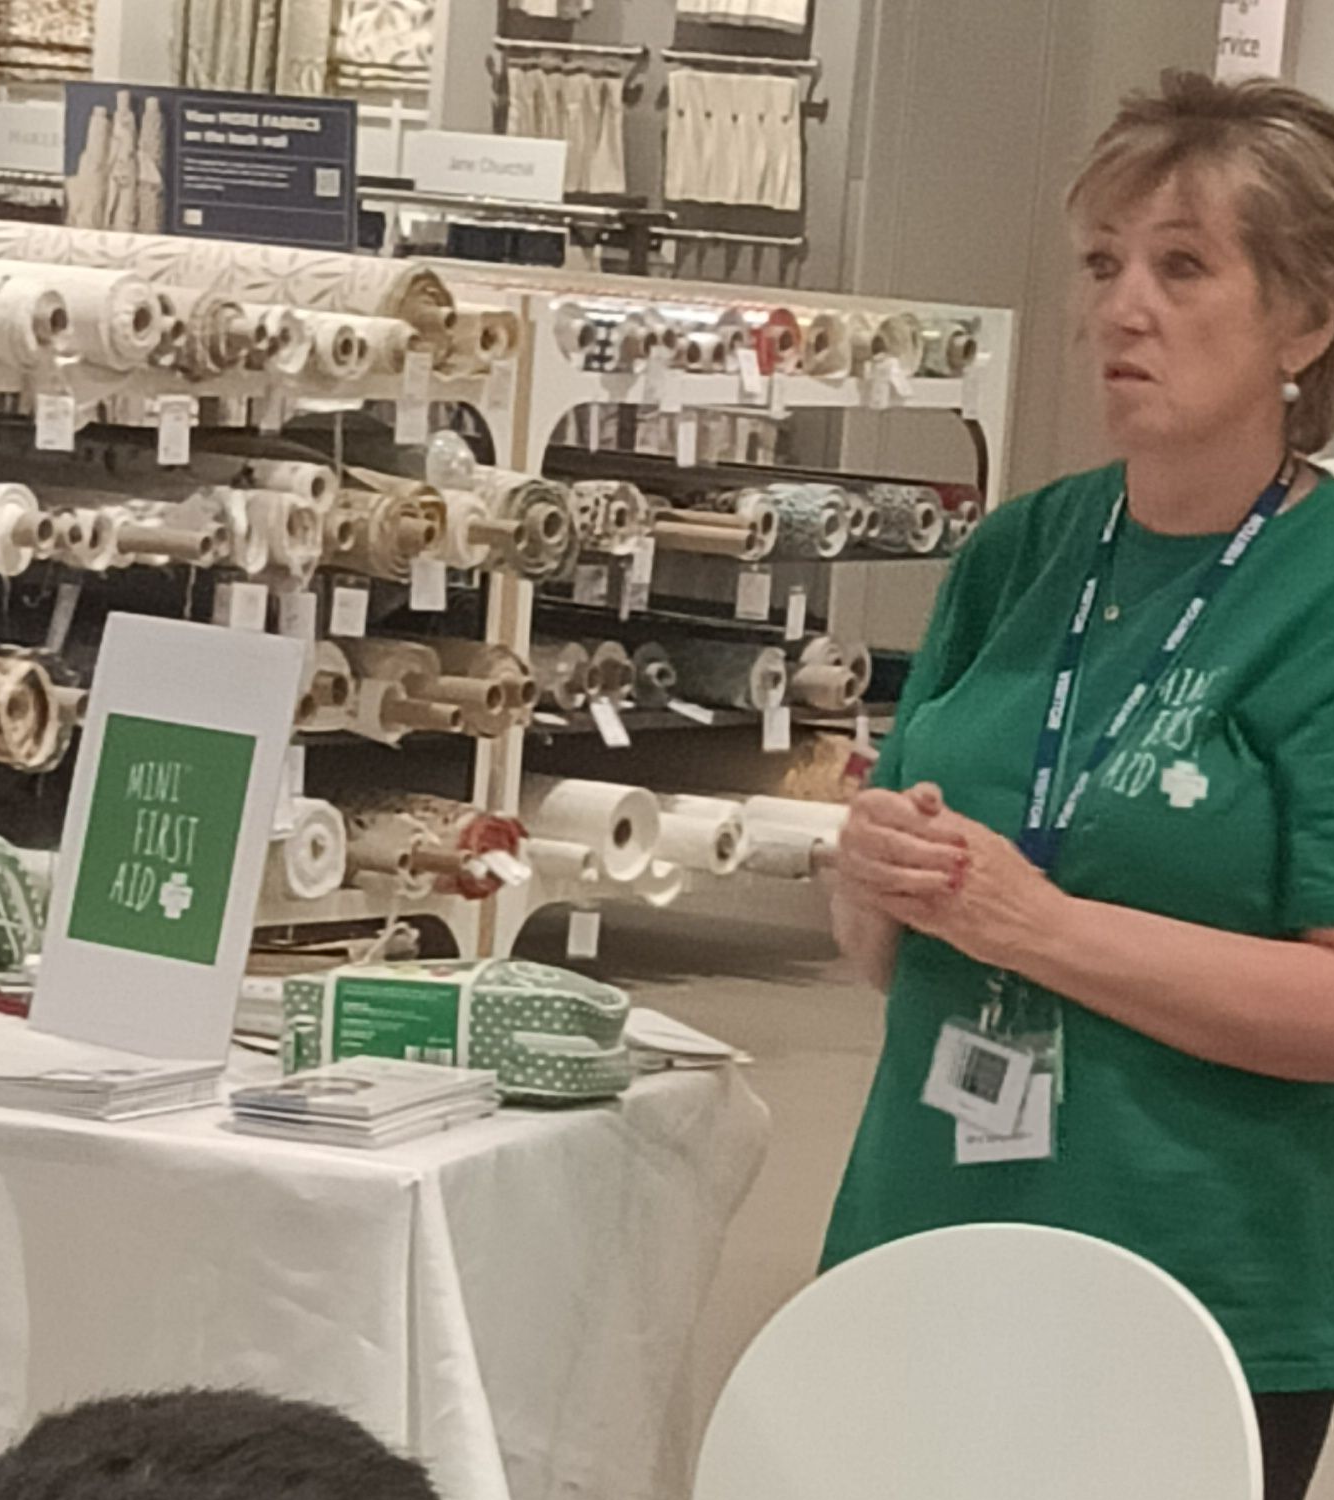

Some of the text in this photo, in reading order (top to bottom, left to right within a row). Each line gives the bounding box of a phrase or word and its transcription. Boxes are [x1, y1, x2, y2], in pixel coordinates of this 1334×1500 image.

[1219, 512, 1265, 566] VISITOR
[125, 760, 182, 803] MINI
[133, 807, 200, 867] FIRST
[108, 862, 157, 912] AID
